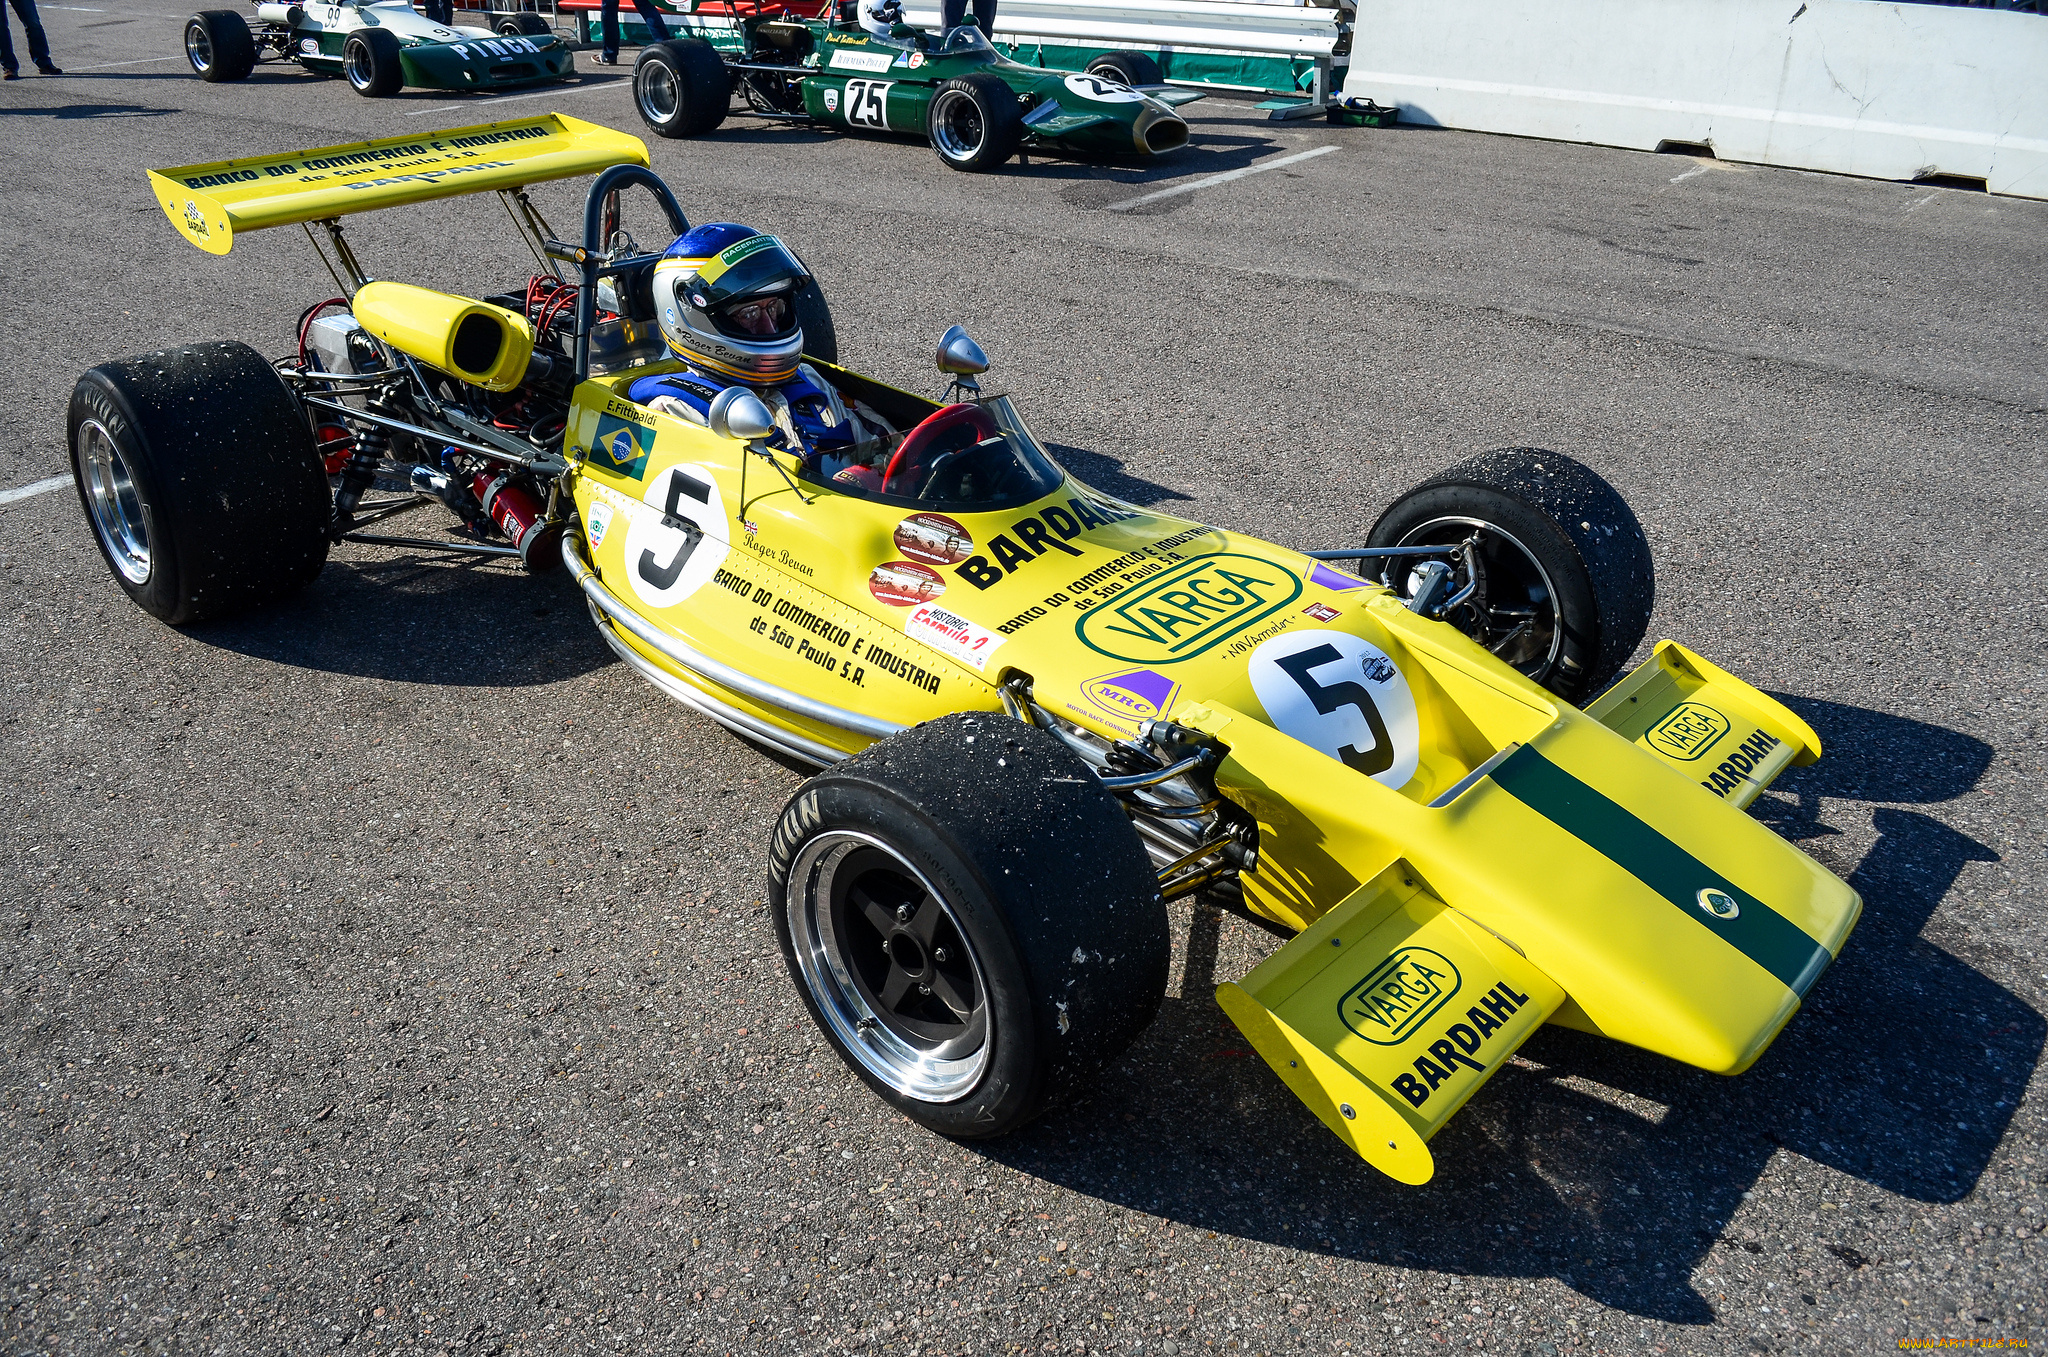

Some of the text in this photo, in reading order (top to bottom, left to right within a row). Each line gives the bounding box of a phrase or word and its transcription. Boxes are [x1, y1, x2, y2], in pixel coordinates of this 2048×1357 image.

[325, 7, 341, 28] 99
[824, 32, 841, 43] Paul
[449, 37, 541, 60] PINCH
[911, 54, 921, 67] E
[849, 81, 888, 127] 25
[183, 126, 550, 189] BANCO DO COMMERCIO E INDUSTRIA
[298, 174, 330, 183] de
[379, 156, 442, 170] Paulo
[341, 160, 515, 190] BARDAHL
[722, 235, 773, 261] RACEPARTS
[680, 331, 752, 364] Roger Bevan
[84, 386, 126, 437] AVON
[606, 400, 658, 427] E.Fittipaldi
[638, 469, 711, 590] 5
[742, 533, 814, 578] Roger Bevan
[996, 606, 1048, 635] BANCO
[1043, 592, 1071, 608] DO
[1066, 550, 1147, 595] COMMERCIO
[1141, 546, 1158, 557] E
[1074, 550, 1189, 612] de São Paulo S.A.
[928, 608, 969, 631] HISTORIC
[1105, 568, 1275, 645] VARGA
[713, 567, 942, 695] BANCO DO COMMERCIO E INDUSTRIA
[749, 615, 866, 689] de São Paulo S.A.
[1066, 702, 1089, 718] MOTOR
[1088, 711, 1104, 725] RACE
[1098, 686, 1151, 713] MRC
[1273, 643, 1394, 777] 5
[1657, 711, 1720, 751] VARGA
[1700, 728, 1782, 799] BARDAHL
[769, 788, 823, 889] AVON
[1353, 961, 1447, 1029] VARGA
[1390, 980, 1531, 1109] BARDAHL
